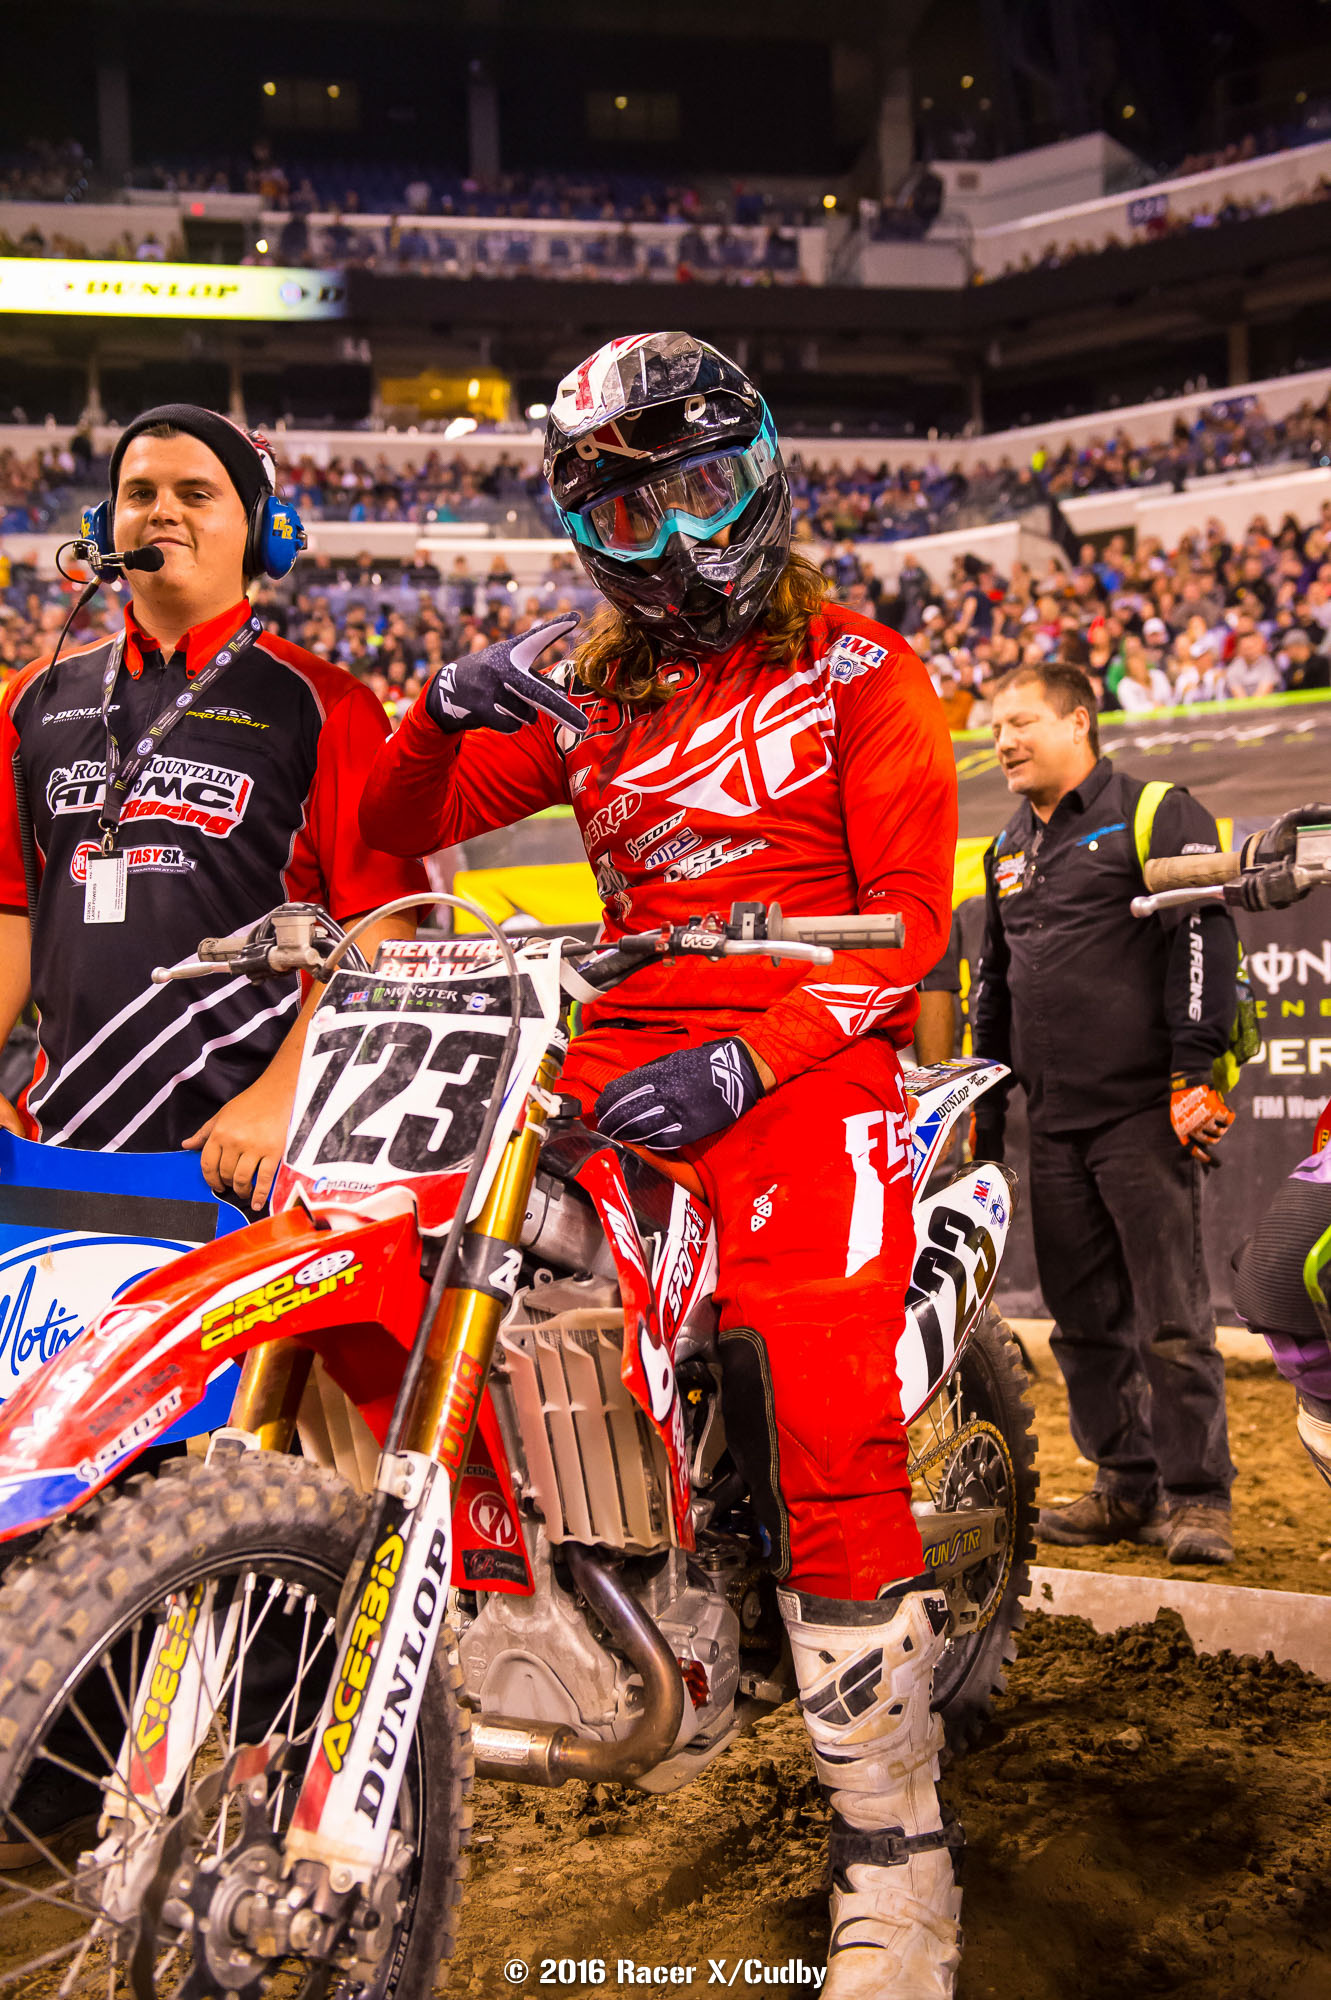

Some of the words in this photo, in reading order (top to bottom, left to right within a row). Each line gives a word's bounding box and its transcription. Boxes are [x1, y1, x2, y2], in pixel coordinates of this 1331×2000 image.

[53, 704, 121, 720] DUNLP
[186, 710, 215, 719] PRO
[215, 715, 270, 730] CIRCUIT
[635, 812, 686, 852] SCOTT
[645, 827, 703, 870] WPS
[127, 848, 182, 866] TASYSX
[663, 836, 733, 884] DIRT
[683, 837, 771, 882] RIDER
[381, 941, 508, 957] RENTHA
[1188, 931, 1205, 1023] RACING
[286, 1021, 510, 1173] 723
[935, 1085, 971, 1120] DUNLOP
[972, 1179, 991, 1209] AMA
[201, 1274, 295, 1332] PRO
[201, 1262, 364, 1352] CIRCUIT
[321, 1533, 404, 1773] ACERBIS
[354, 1528, 448, 1829] DUNLOP
